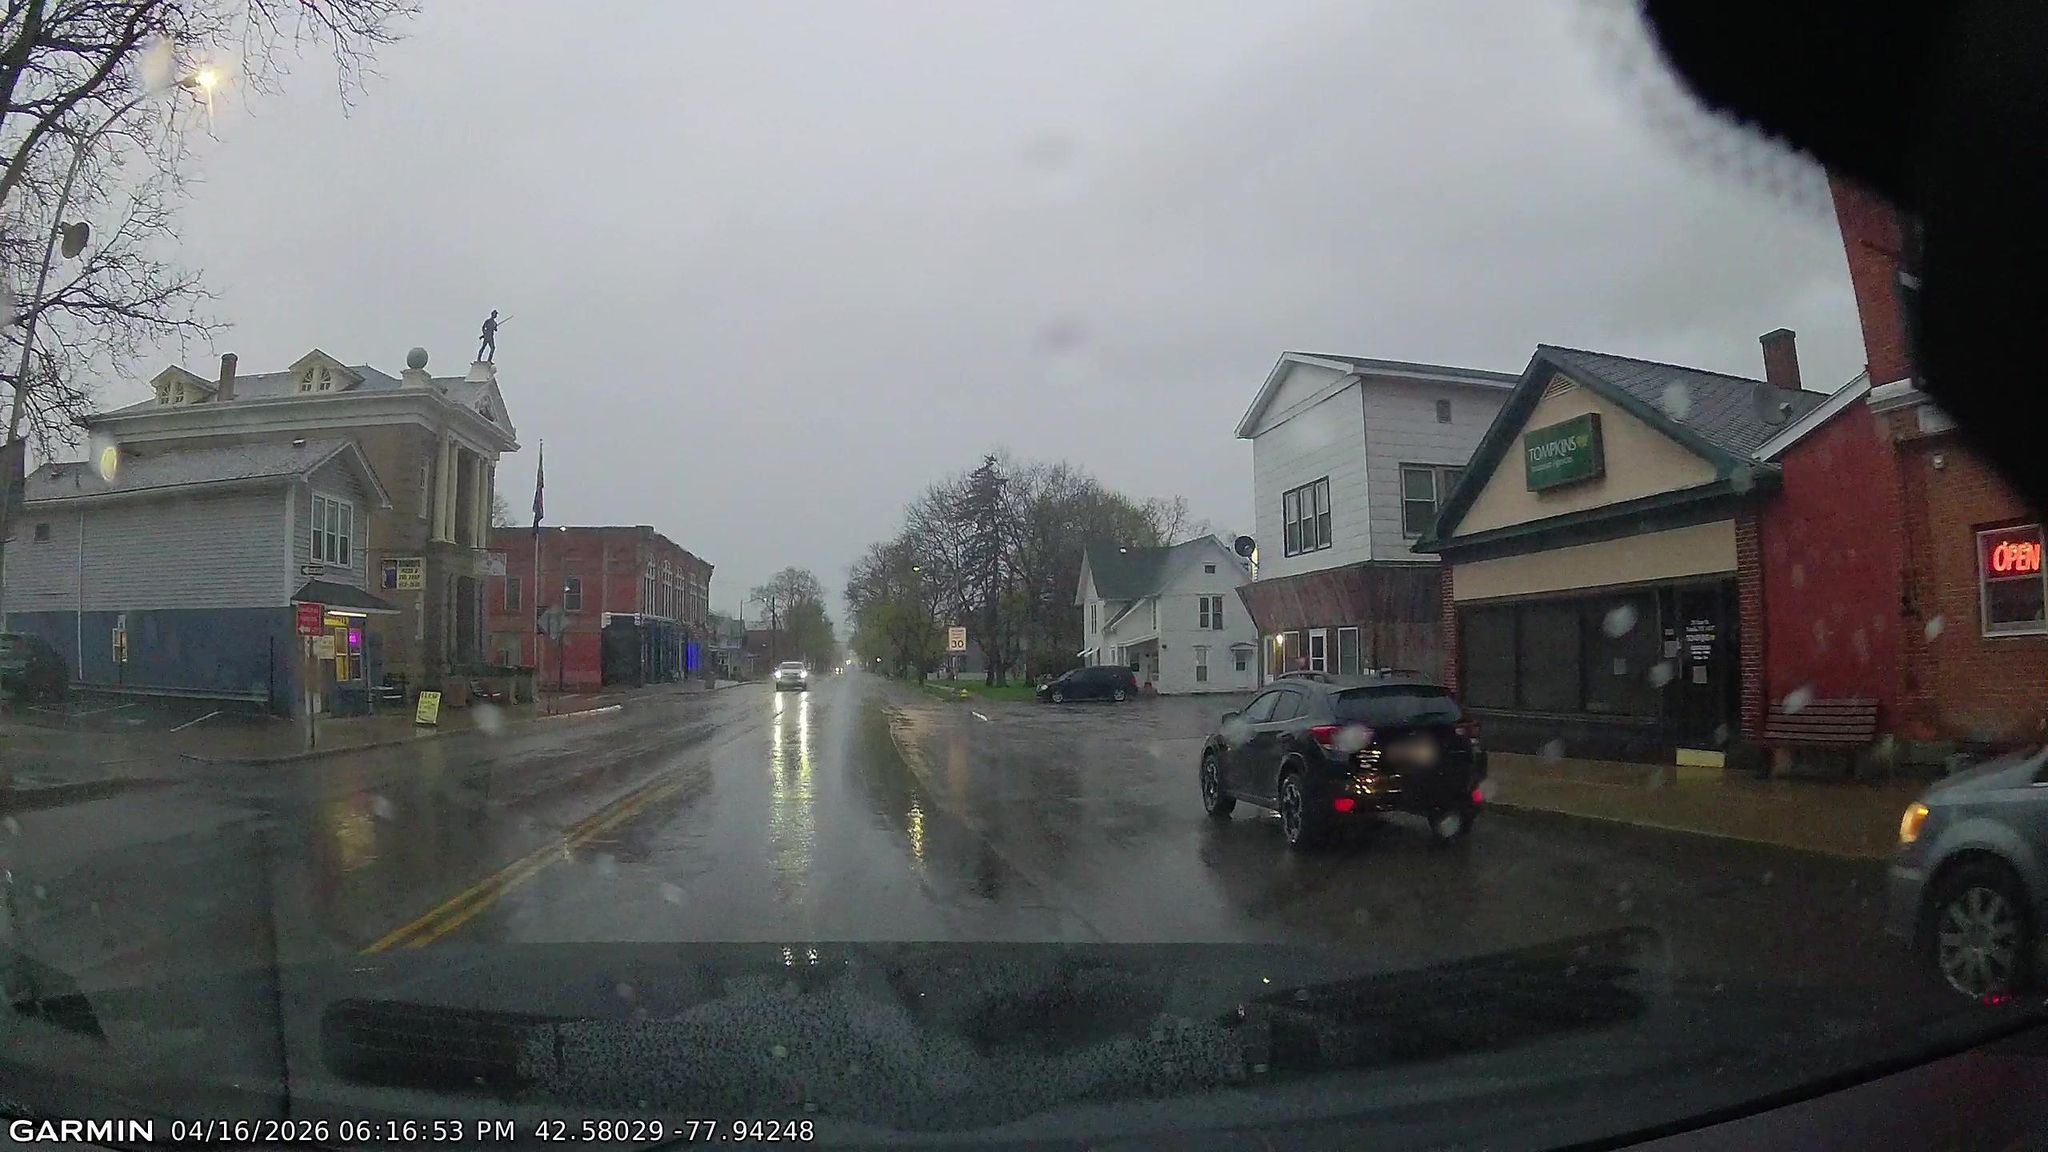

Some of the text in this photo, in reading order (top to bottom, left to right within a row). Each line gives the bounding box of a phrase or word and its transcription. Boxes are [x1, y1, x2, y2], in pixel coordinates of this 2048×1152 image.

[1528, 435, 1577, 462] TOMPKINS
[1992, 541, 2041, 571] OPEN
[951, 639, 964, 648] 30
